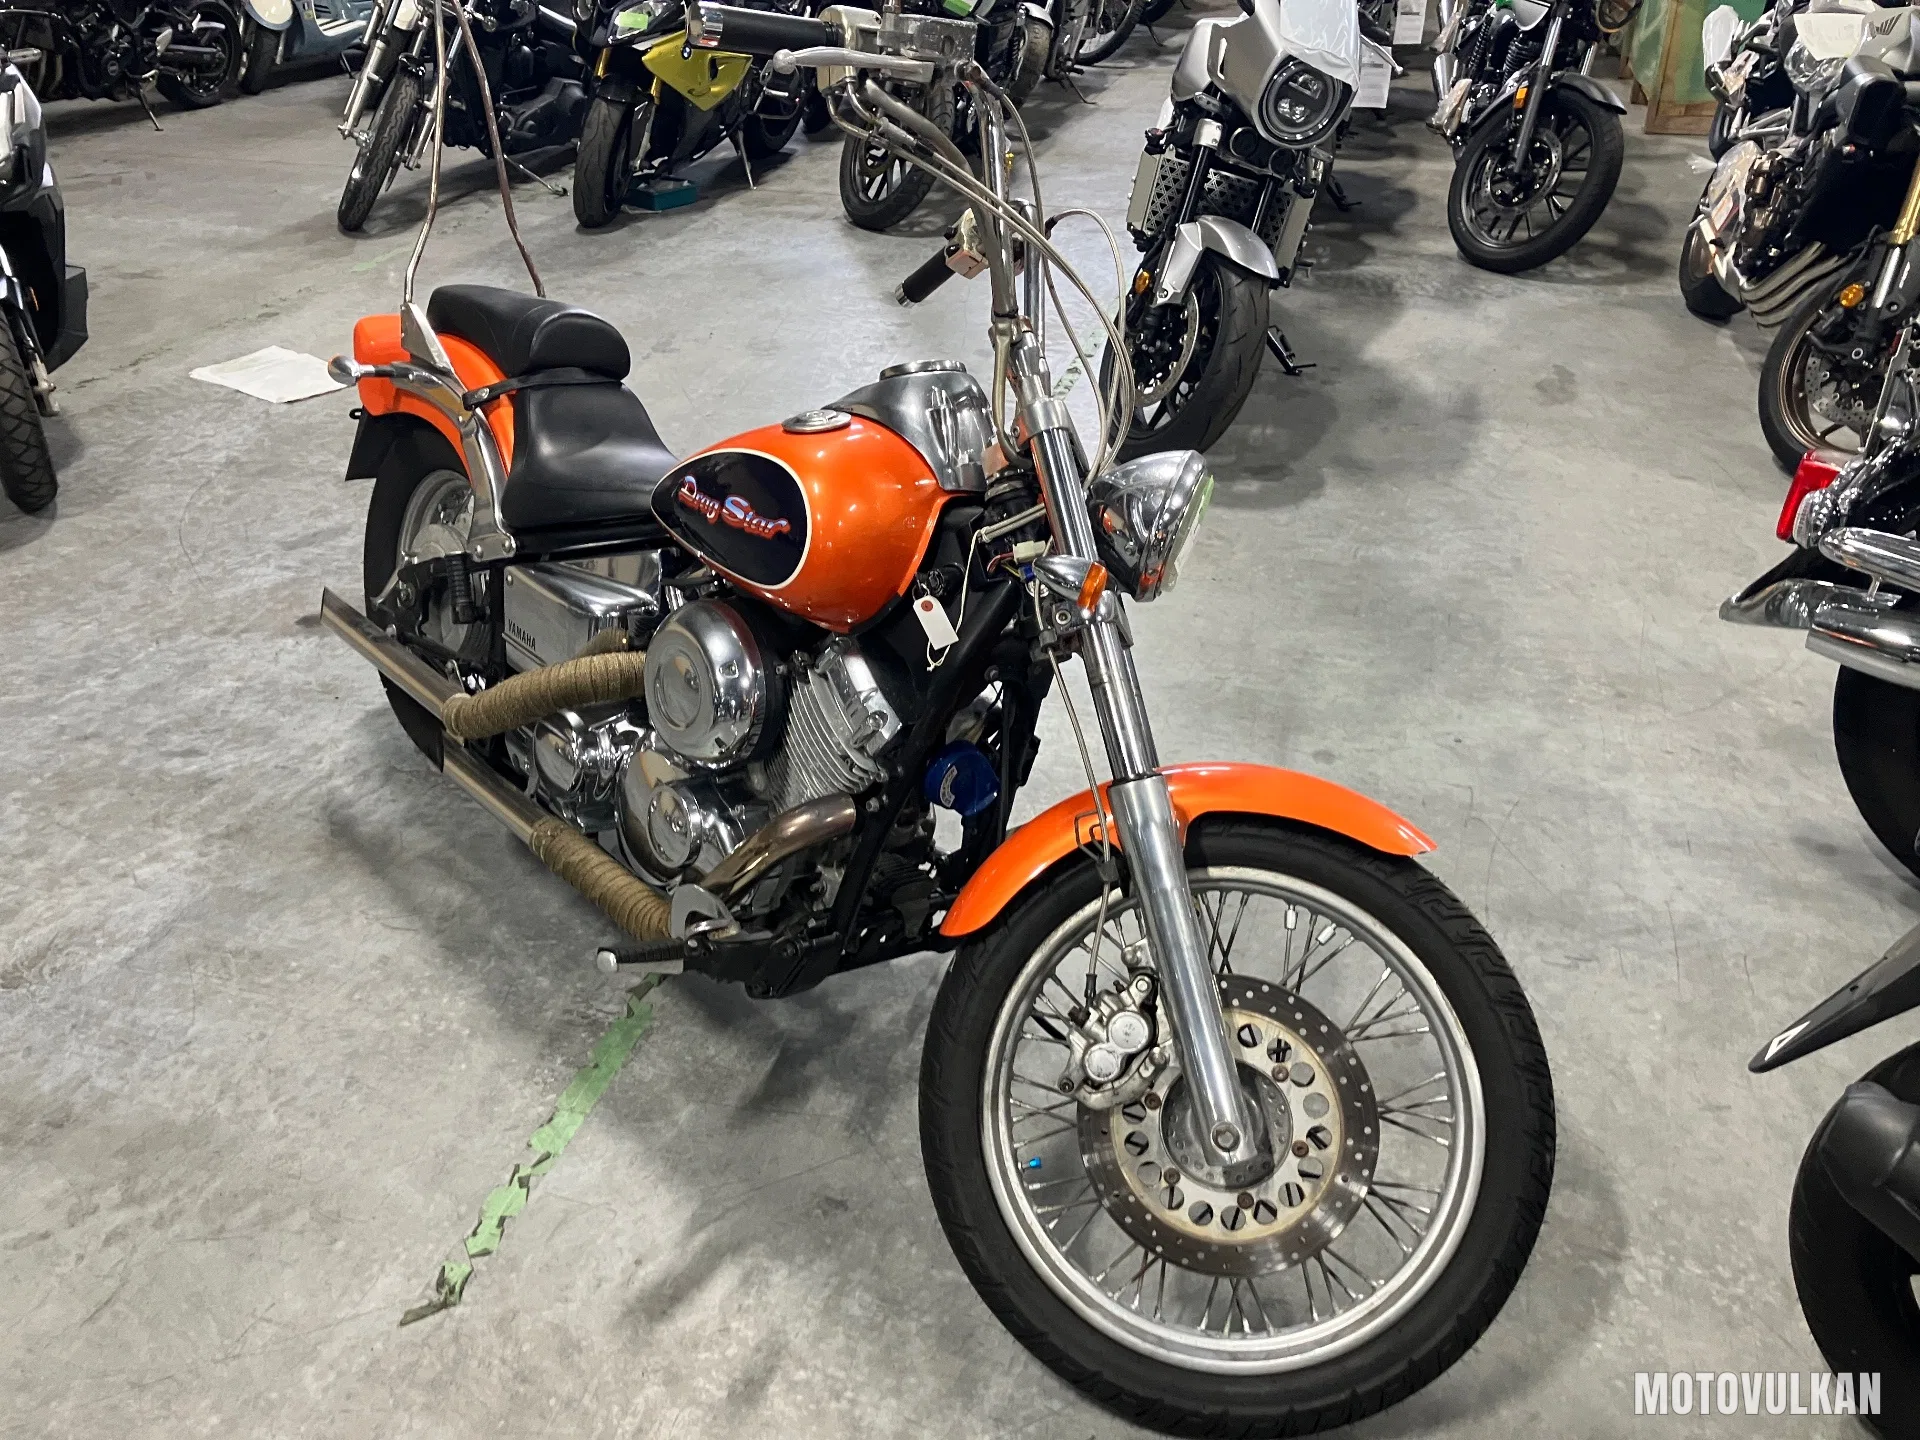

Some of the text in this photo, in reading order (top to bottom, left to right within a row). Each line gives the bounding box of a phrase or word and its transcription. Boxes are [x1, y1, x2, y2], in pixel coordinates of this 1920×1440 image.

[679, 475, 791, 538] Drag Star
[508, 619, 536, 651] YAMAHA
